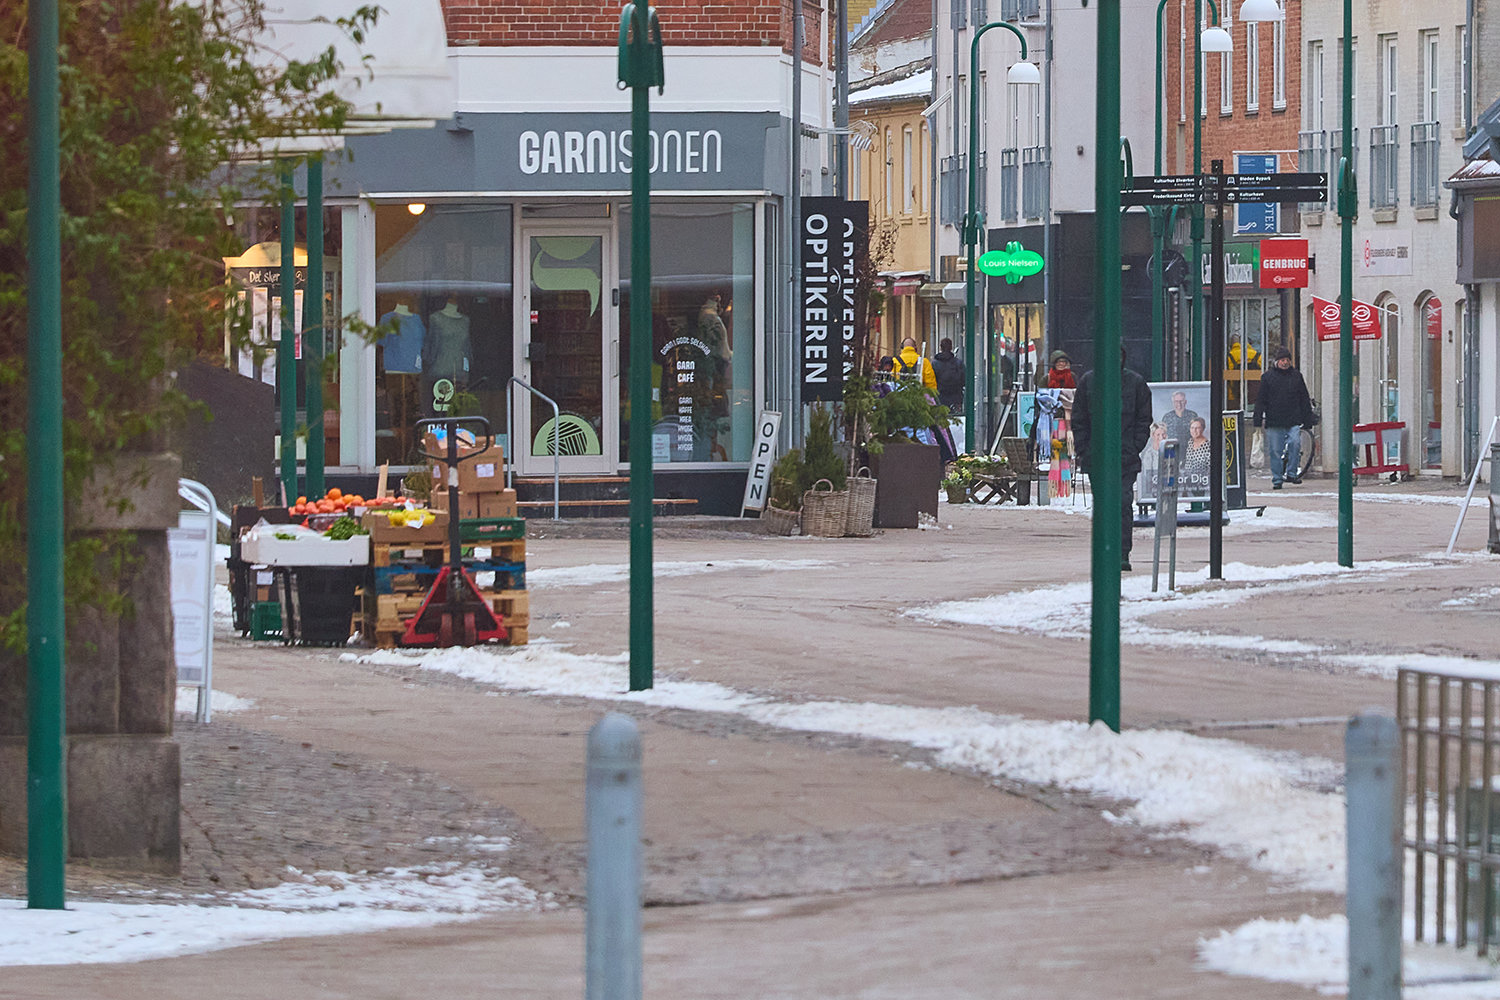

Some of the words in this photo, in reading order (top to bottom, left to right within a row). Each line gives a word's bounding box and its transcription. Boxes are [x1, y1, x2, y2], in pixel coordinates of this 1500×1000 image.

[984, 259, 1006, 267] Louis
[1008, 259, 1039, 267] Nielsen
[1263, 258, 1306, 269] GENBRUG
[805, 213, 829, 383] OPTIKEREN
[677, 361, 695, 370] GARN
[677, 372, 694, 383] CAFÉ
[749, 422, 774, 500] OPEN
